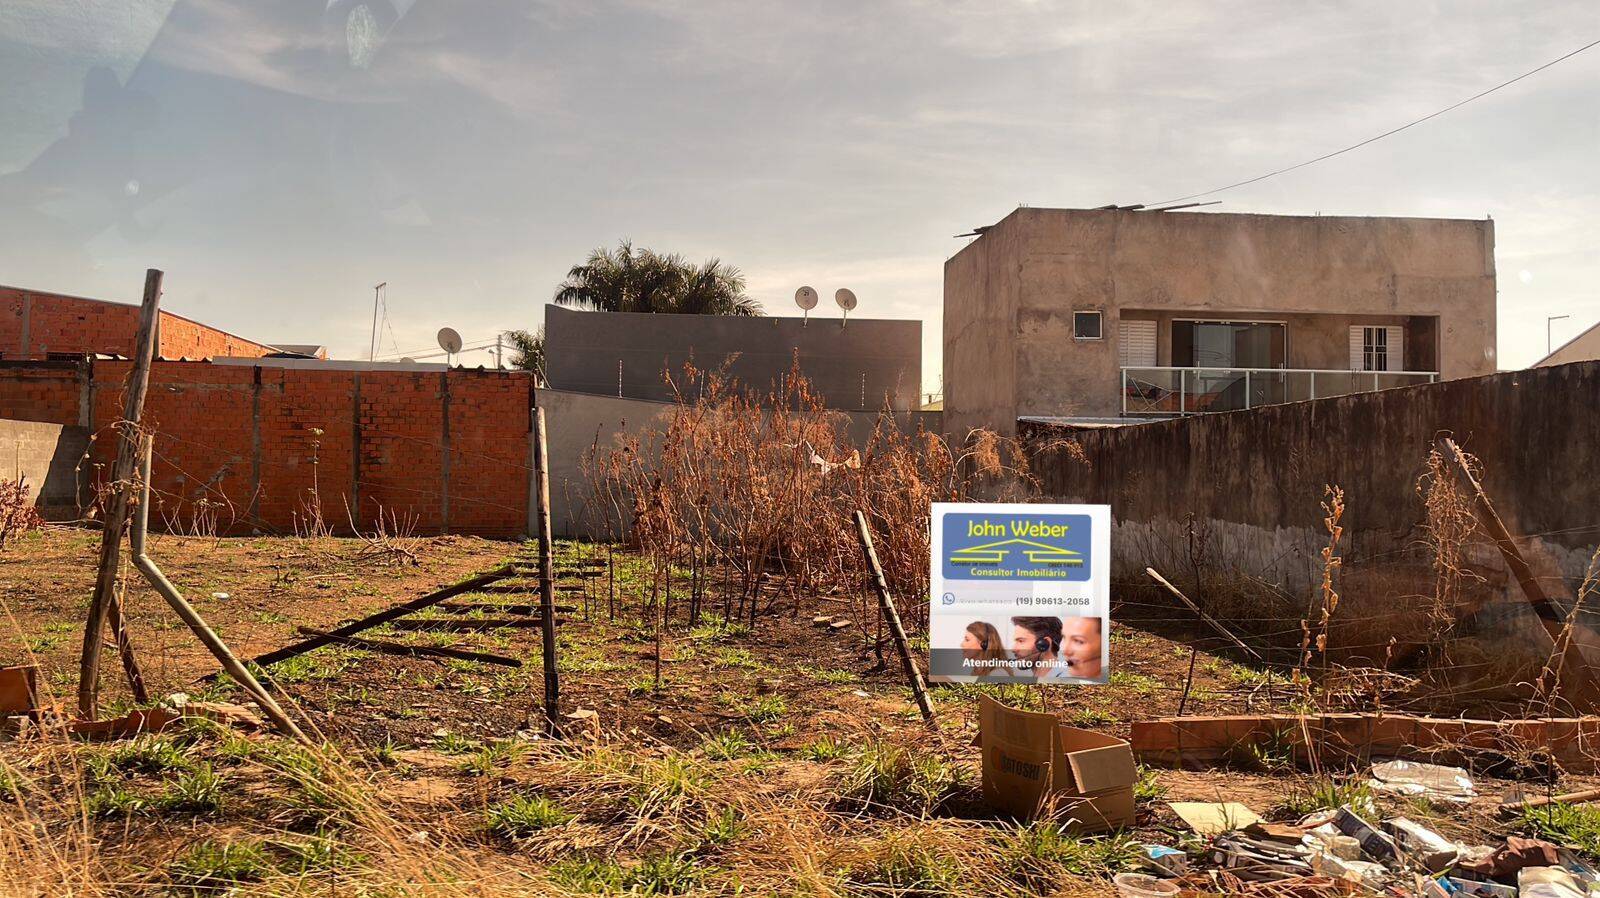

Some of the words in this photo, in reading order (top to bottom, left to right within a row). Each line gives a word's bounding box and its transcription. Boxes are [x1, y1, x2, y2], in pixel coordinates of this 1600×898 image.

[967, 519, 1006, 538] John
[1010, 520, 1069, 538] Weber
[970, 567, 1014, 578] Consultor
[1017, 567, 1067, 578] Imobiliário
[1015, 597, 1033, 606] (19)
[1035, 597, 1090, 606] 99613-2058
[962, 657, 1033, 668] Atendimento
[1035, 658, 1069, 668] online
